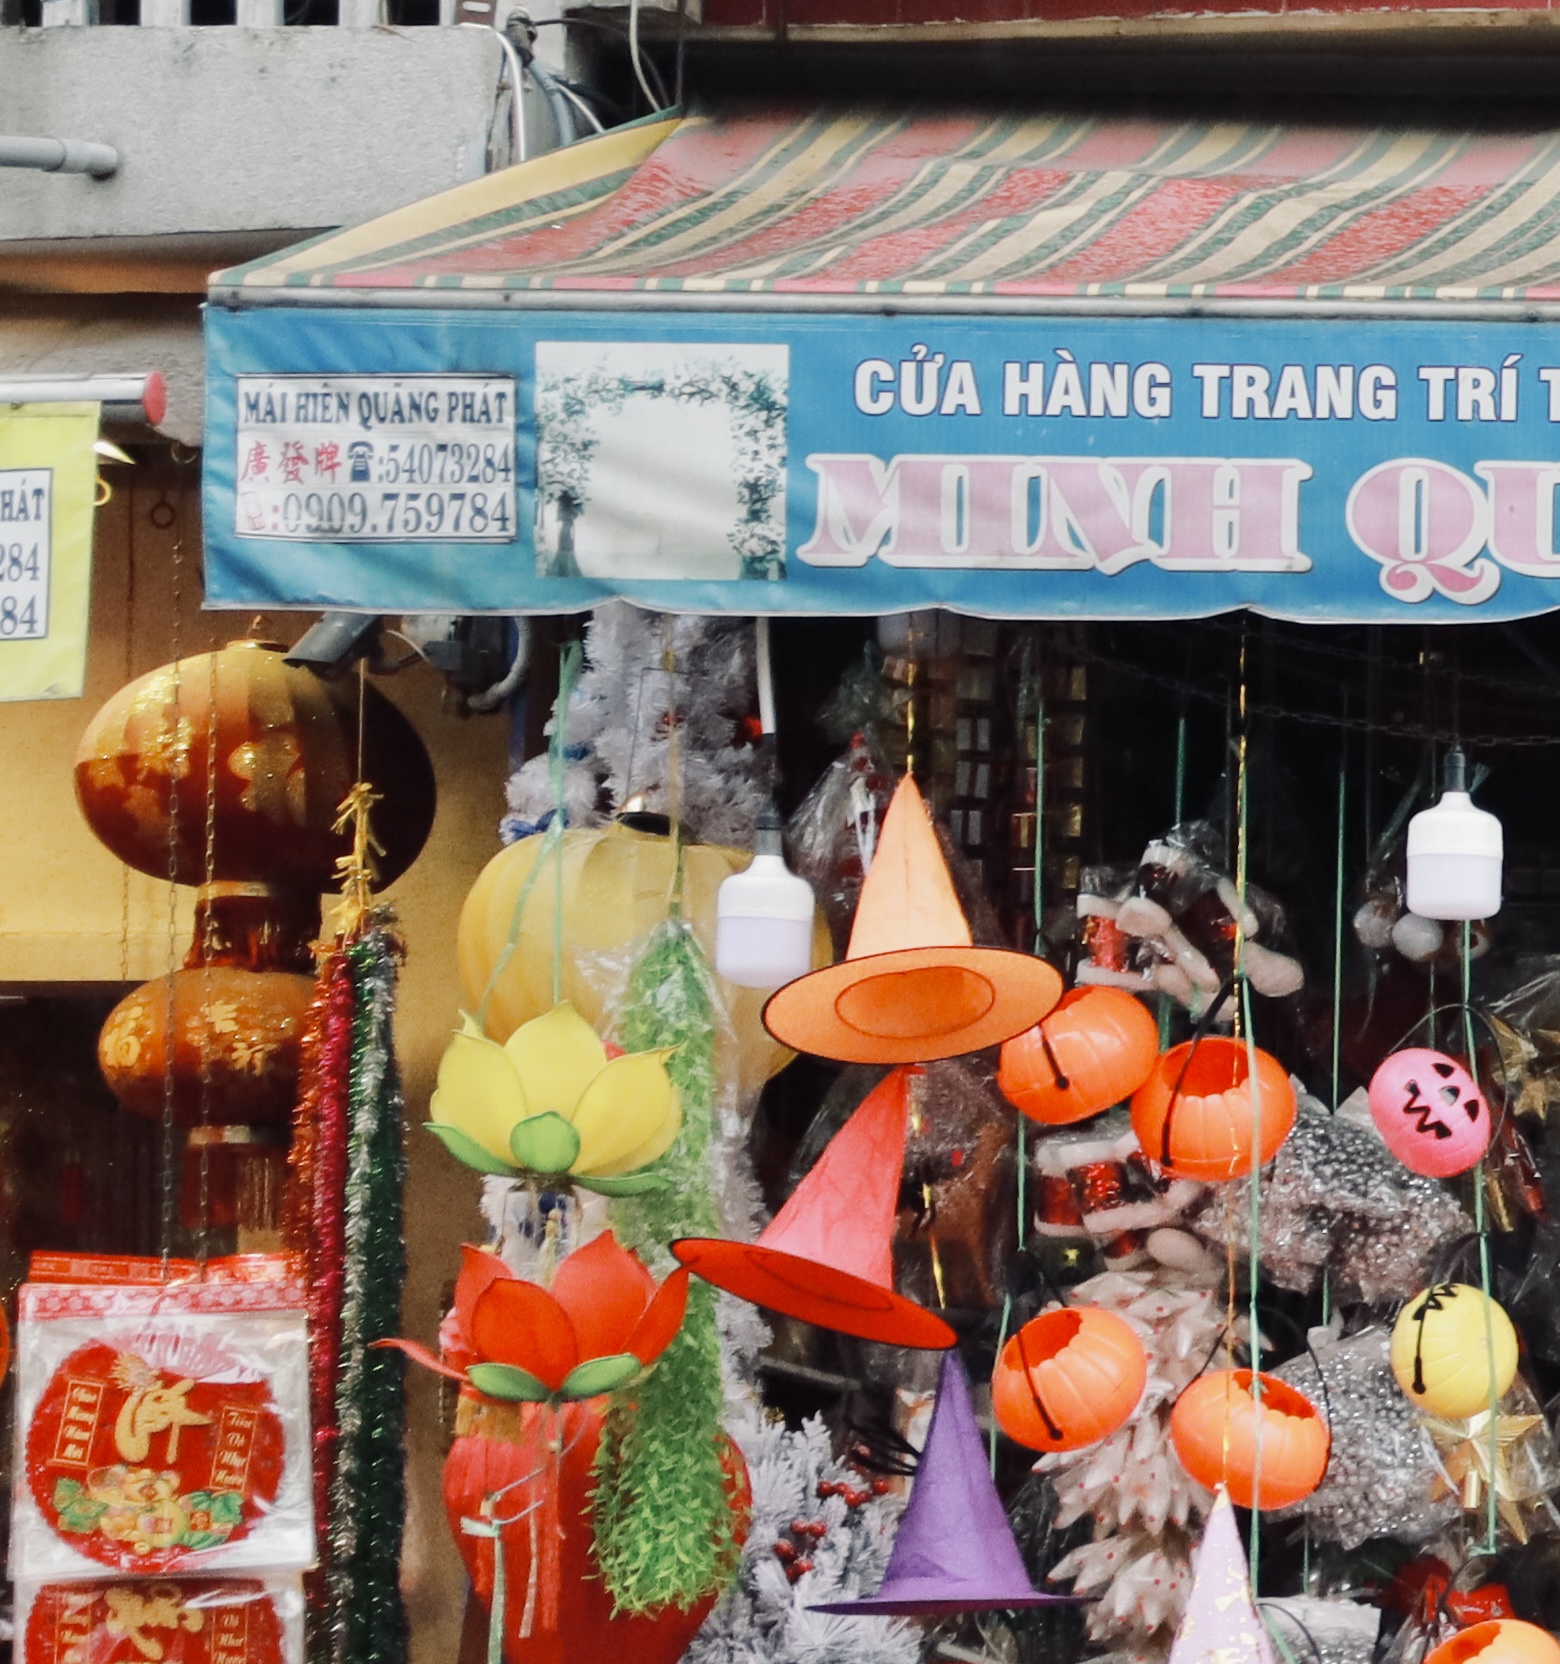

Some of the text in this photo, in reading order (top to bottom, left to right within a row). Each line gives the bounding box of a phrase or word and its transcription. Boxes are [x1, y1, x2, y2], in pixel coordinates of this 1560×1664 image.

[244, 382, 287, 424] MÁI
[294, 382, 350, 424] HIÊN
[446, 382, 508, 424] PHÁT
[854, 344, 982, 420] CỬA
[1001, 352, 1172, 420] HÀNG
[1193, 363, 1398, 422] TRANG
[1418, 355, 1520, 424] TRÍ
[798, 451, 1314, 577] MINH
